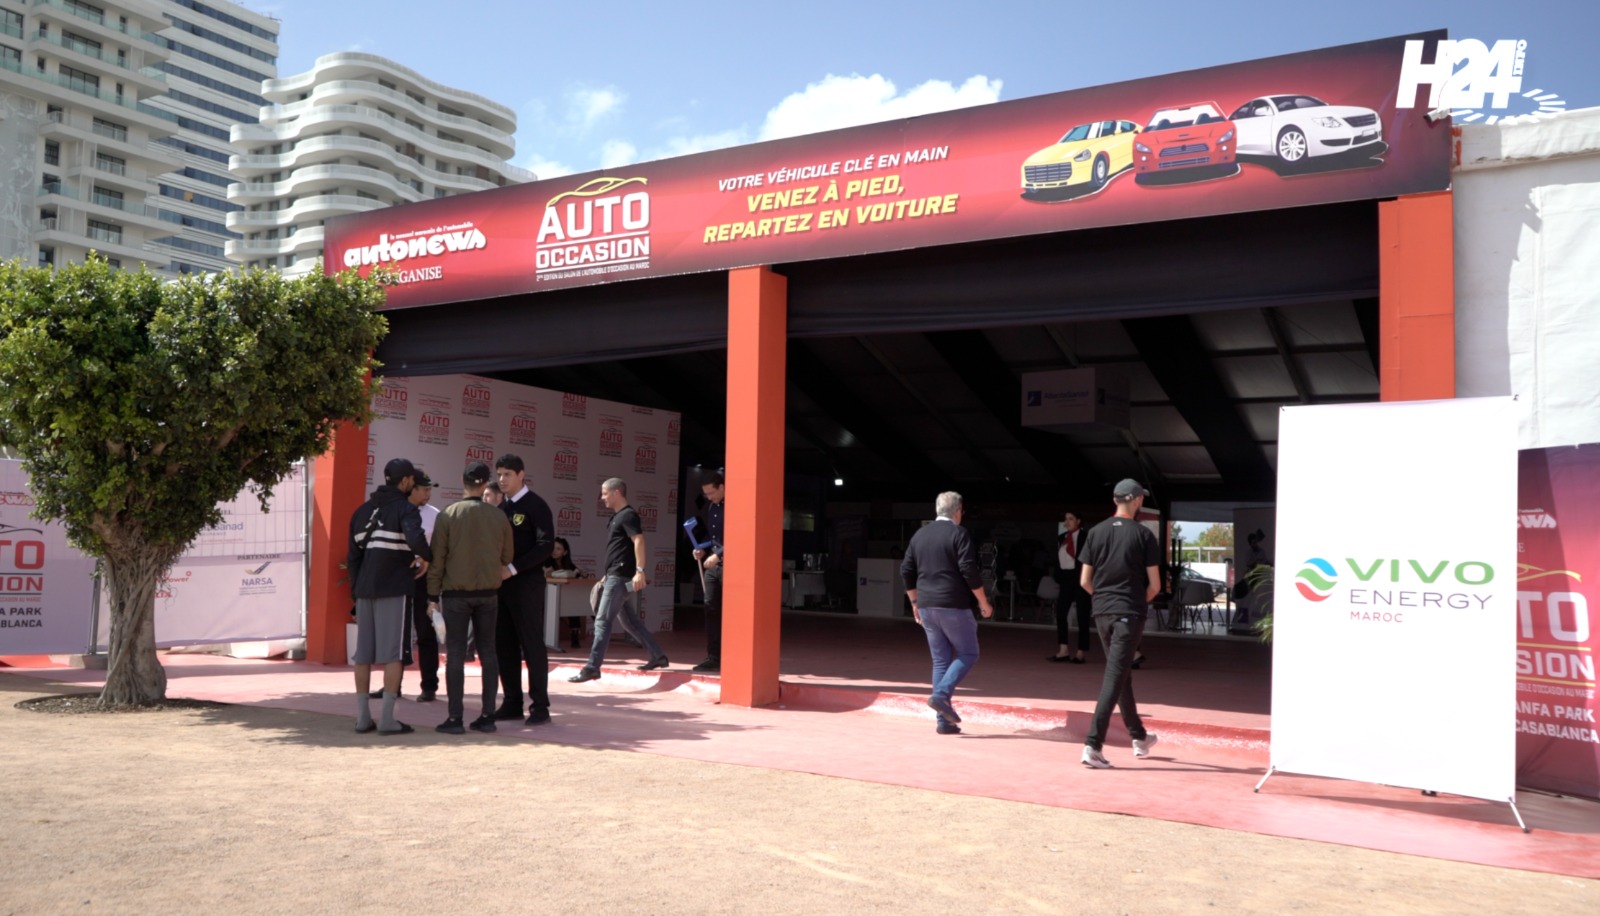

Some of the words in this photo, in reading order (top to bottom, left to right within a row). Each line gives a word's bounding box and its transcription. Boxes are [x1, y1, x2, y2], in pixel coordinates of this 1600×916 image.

[718, 173, 764, 192] VOTRE
[767, 160, 840, 184] VÉHICULE
[843, 154, 875, 174] CLÉ
[877, 153, 902, 169] EN
[903, 145, 949, 165] MAIN
[747, 185, 820, 213] VENEZ
[822, 179, 840, 203] À
[845, 174, 905, 199] PIED,
[536, 191, 650, 243] AUTO
[703, 213, 814, 243] REPARTEZ
[817, 208, 850, 229] EN
[856, 193, 959, 224] VOITURE
[535, 236, 650, 269] OCCASION
[463, 385, 491, 401] AUTO
[420, 414, 450, 428] AUTO
[510, 417, 537, 431] AUTO
[600, 431, 623, 443] AUTO
[466, 447, 494, 461] AUTO
[554, 452, 578, 465] AUTO
[635, 446, 657, 460] AUTO
[557, 509, 582, 521] AUTO
[237, 553, 281, 561] PARTENAIRE
[1344, 557, 1495, 586] VIVO
[242, 577, 273, 587] NARSA
[1350, 588, 1493, 610] ENERGY
[10, 607, 42, 616] PARK
[1350, 611, 1404, 623] MAROC
[1516, 590, 1590, 643] TO
[1, 619, 42, 629] BLANCA
[1554, 705, 1597, 723] PARK
